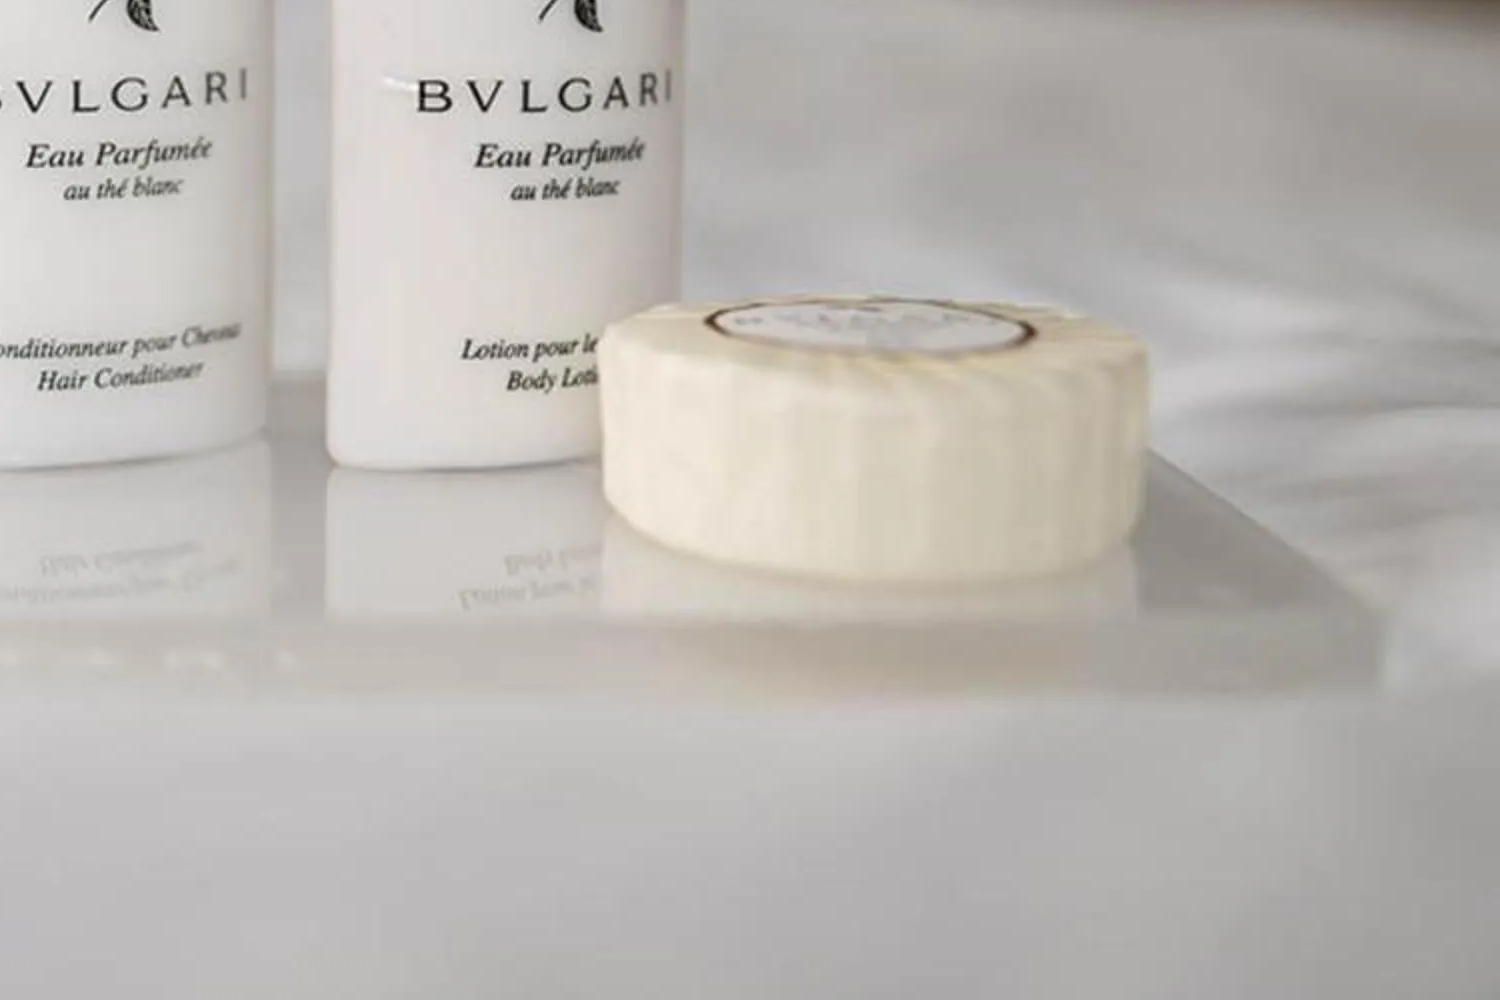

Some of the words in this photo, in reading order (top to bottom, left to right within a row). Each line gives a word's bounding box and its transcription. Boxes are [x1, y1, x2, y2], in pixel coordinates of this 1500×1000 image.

[415, 69, 672, 115] BVLGARI
[24, 142, 85, 169] Eau
[94, 135, 213, 171] Parfumée
[472, 142, 533, 169] Eau
[540, 135, 646, 171] Parfumée
[62, 184, 92, 201] au
[95, 177, 130, 201] thé
[131, 175, 184, 199] blanc
[509, 184, 538, 202] au
[540, 177, 573, 201] thé
[573, 176, 621, 200] blanc
[131, 334, 178, 360] pour
[459, 337, 531, 361] Lotion
[531, 338, 581, 364] pour
[36, 369, 89, 392] Hair
[93, 362, 204, 390] Conditioner
[505, 368, 558, 395] Body
[560, 363, 598, 389] Loti
